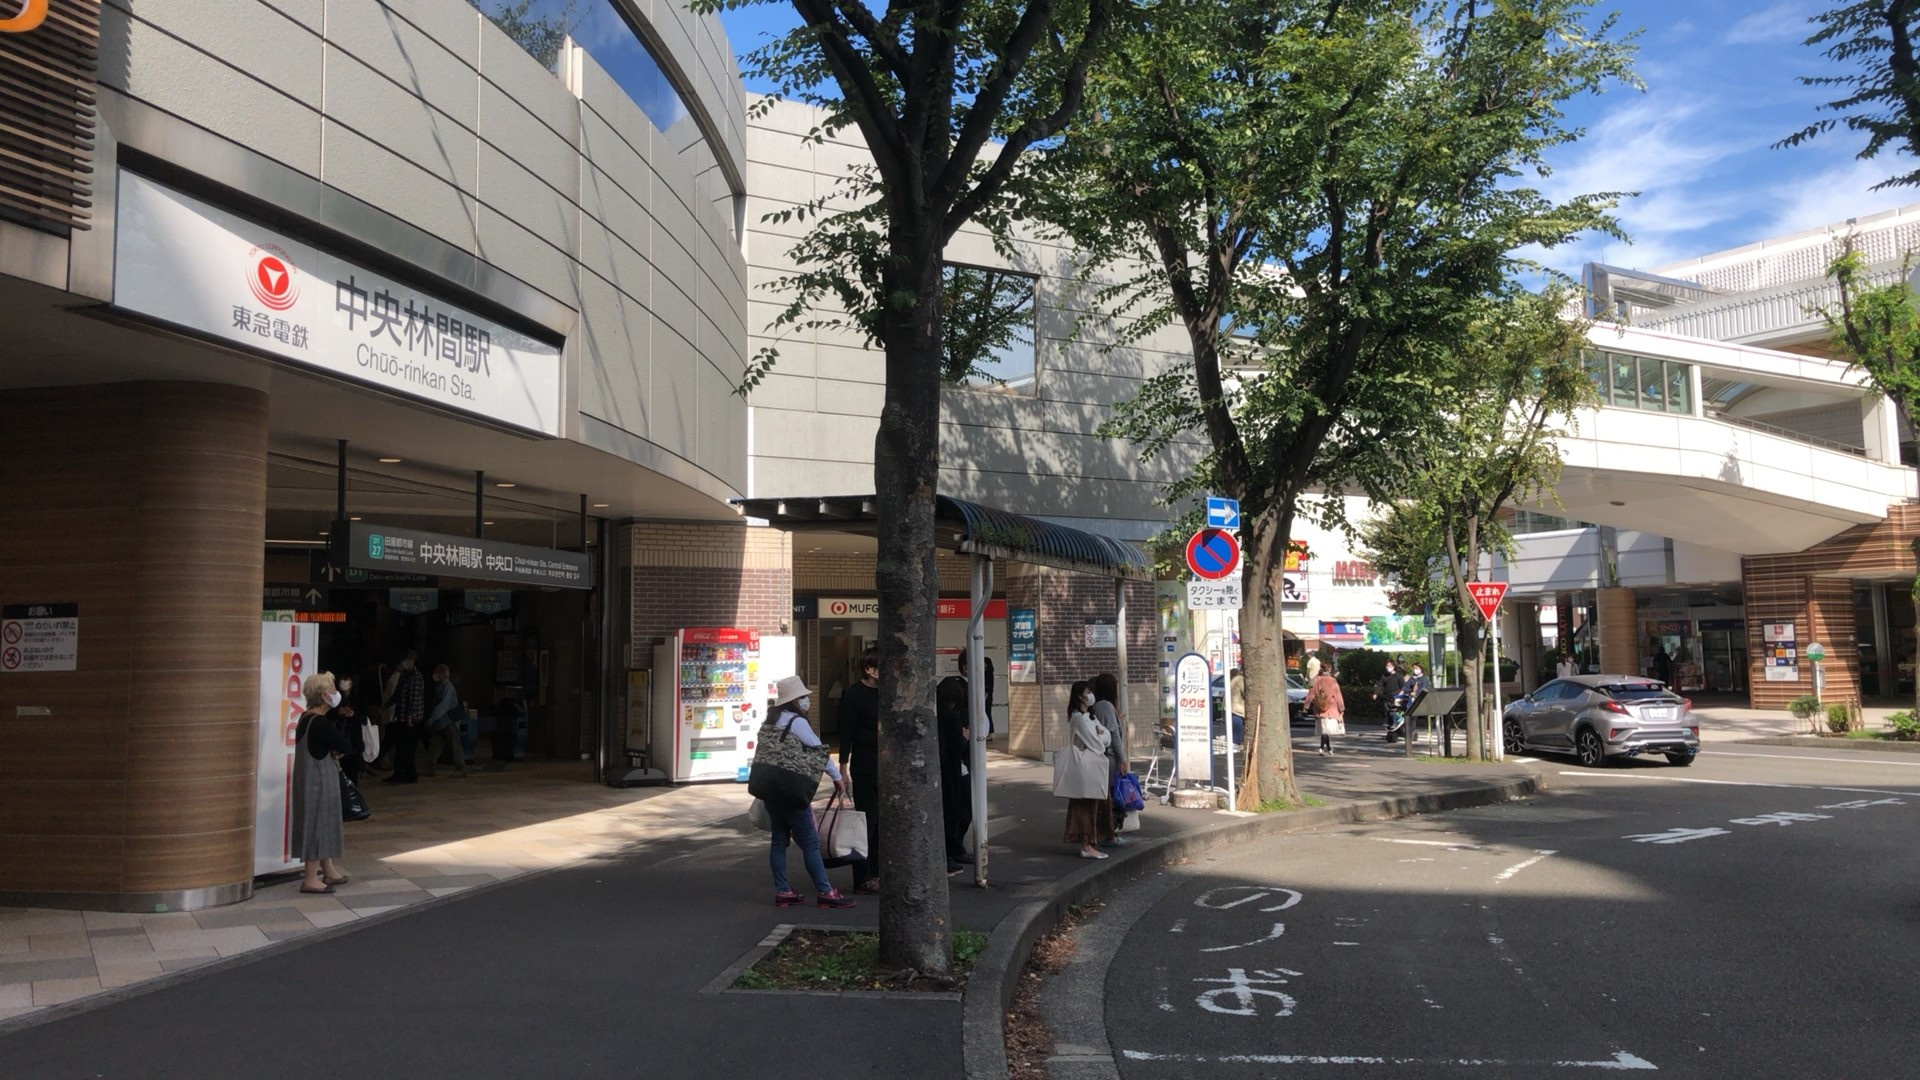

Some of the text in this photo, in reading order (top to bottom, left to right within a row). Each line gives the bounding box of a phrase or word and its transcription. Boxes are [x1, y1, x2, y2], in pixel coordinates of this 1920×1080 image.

[232, 304, 309, 350] 東急電鉄
[335, 275, 491, 377] 中央林間駅
[356, 343, 475, 401] Chūō-rinkan Sta.
[384, 536, 414, 549] 田園都市線
[372, 546, 381, 556] 27
[420, 542, 482, 569] 中央林間駅
[486, 554, 512, 572] 中央口
[562, 562, 578, 571] Entrance
[1299, 560, 1308, 571] 3F
[1300, 573, 1307, 581] 2F
[1190, 585, 1239, 596] タクシーを除く
[1475, 587, 1501, 597] 止まれ
[1192, 596, 1237, 606] ここまで
[1480, 597, 1498, 606] STOP
[27, 606, 53, 617] お願い
[849, 603, 878, 613] MUFG
[1012, 630, 1034, 639] マナビス
[1180, 684, 1205, 694] タクシー
[1180, 698, 1205, 708] のりば
